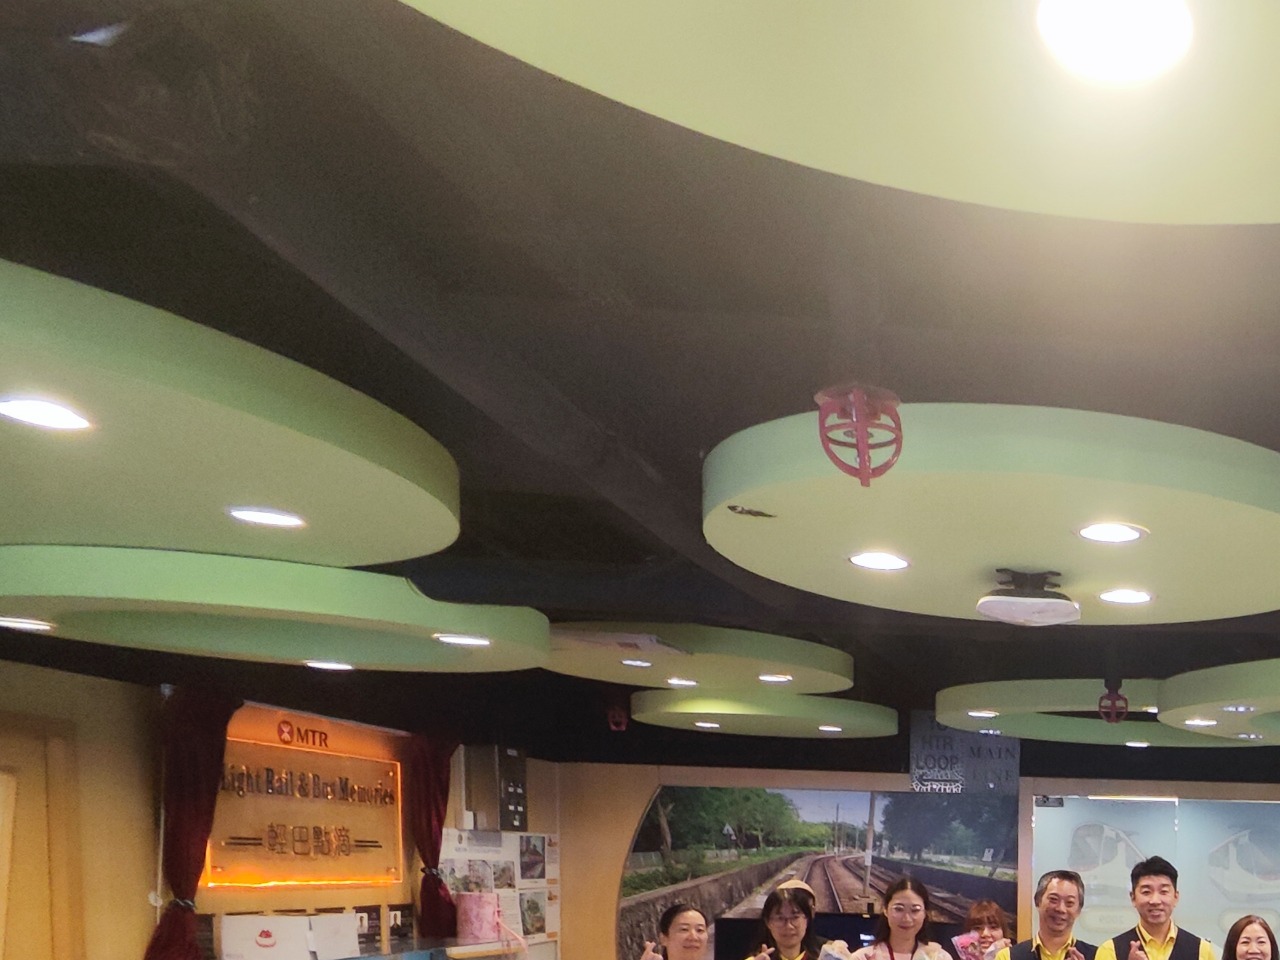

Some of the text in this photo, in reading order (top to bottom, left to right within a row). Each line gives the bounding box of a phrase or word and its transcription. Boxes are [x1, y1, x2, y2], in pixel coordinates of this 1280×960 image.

[296, 728, 328, 747] MTR
[915, 754, 959, 770] LOOP
[264, 768, 293, 796] Rail
[296, 771, 309, 798] &
[309, 772, 336, 800] Bus
[337, 777, 395, 806] Memories
